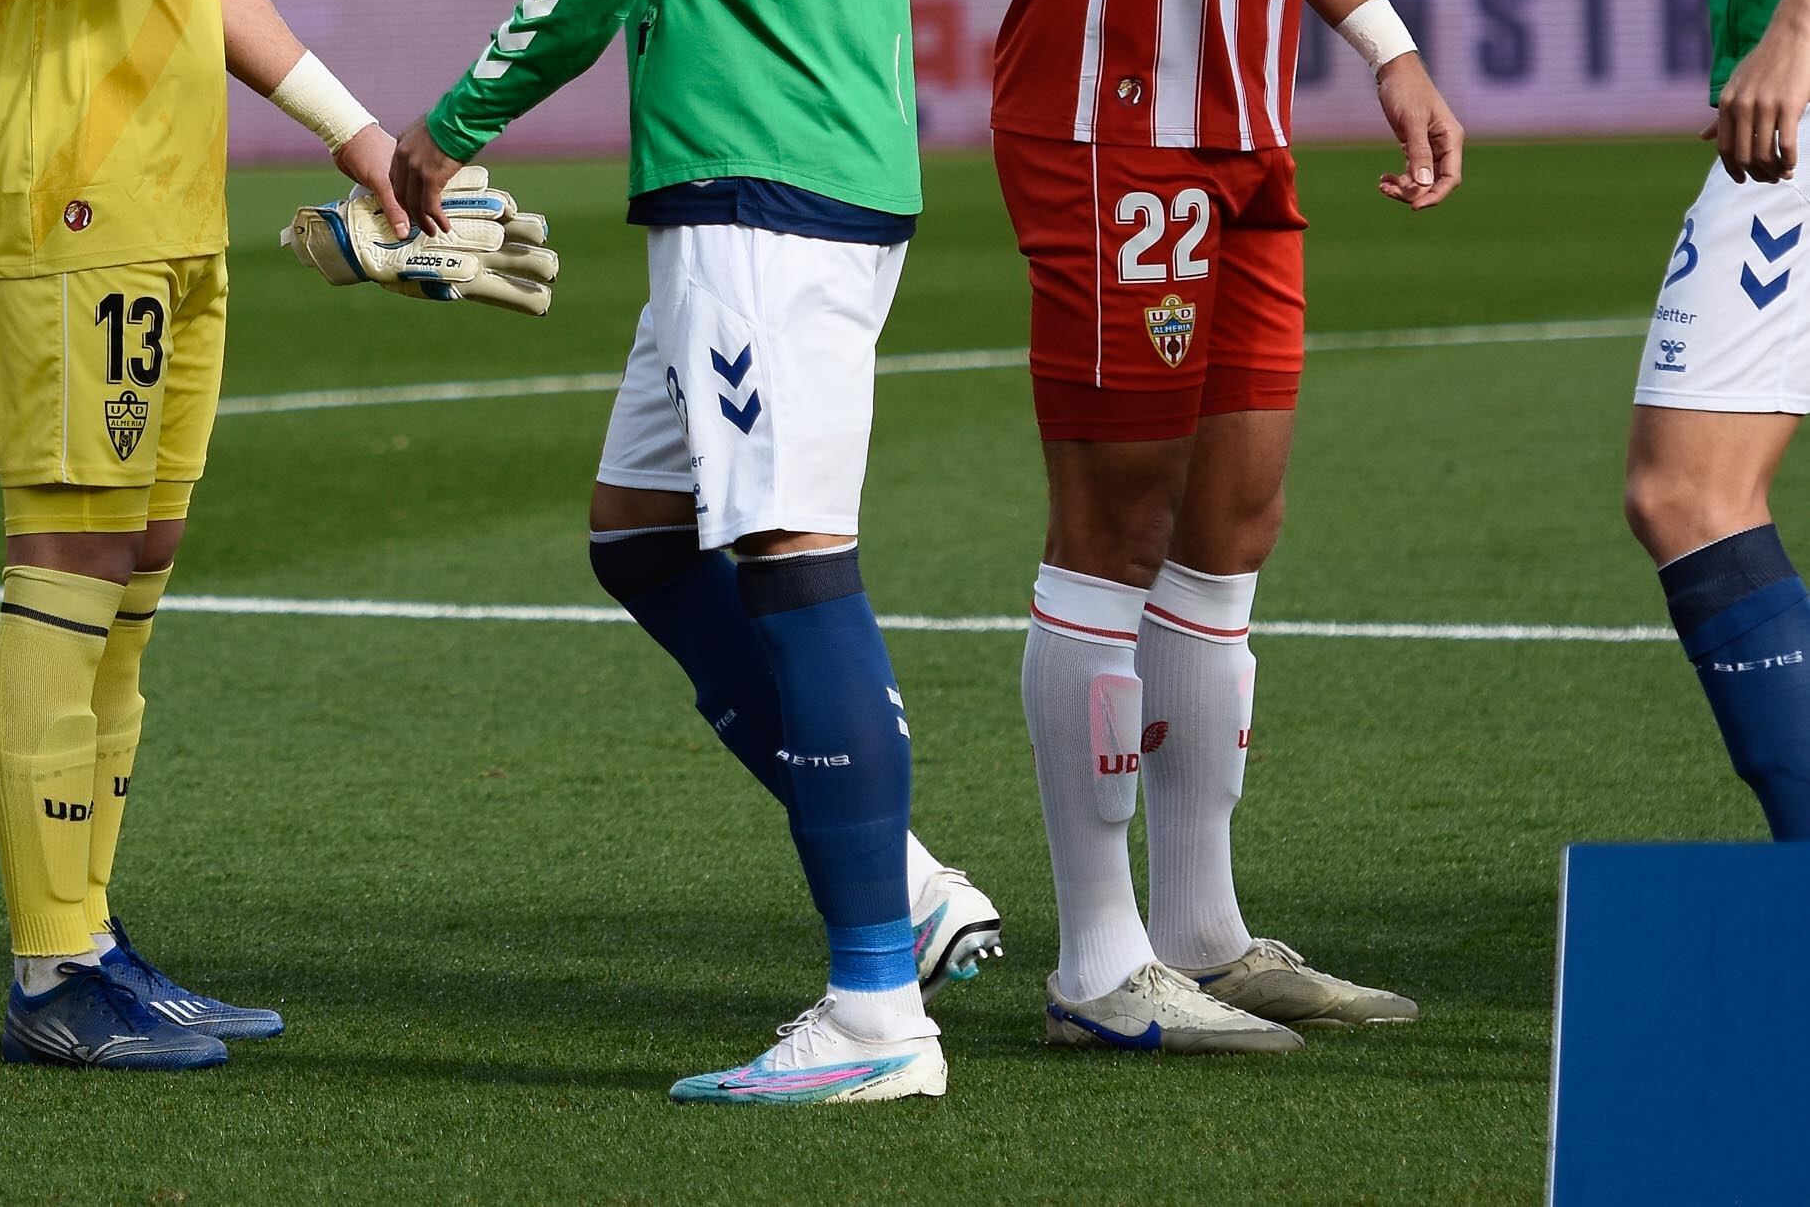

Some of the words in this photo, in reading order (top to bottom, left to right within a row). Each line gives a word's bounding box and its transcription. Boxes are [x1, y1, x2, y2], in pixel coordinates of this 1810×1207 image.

[1115, 188, 1210, 284] 22
[406, 256, 443, 267] SOCCER
[1152, 311, 1164, 322] U
[1181, 308, 1191, 319] D
[1655, 305, 1697, 324] Better
[95, 293, 165, 387] 13
[111, 405, 120, 415] U
[135, 405, 144, 414] D
[110, 419, 143, 428] ALMERIA
[776, 749, 852, 768] BETIS
